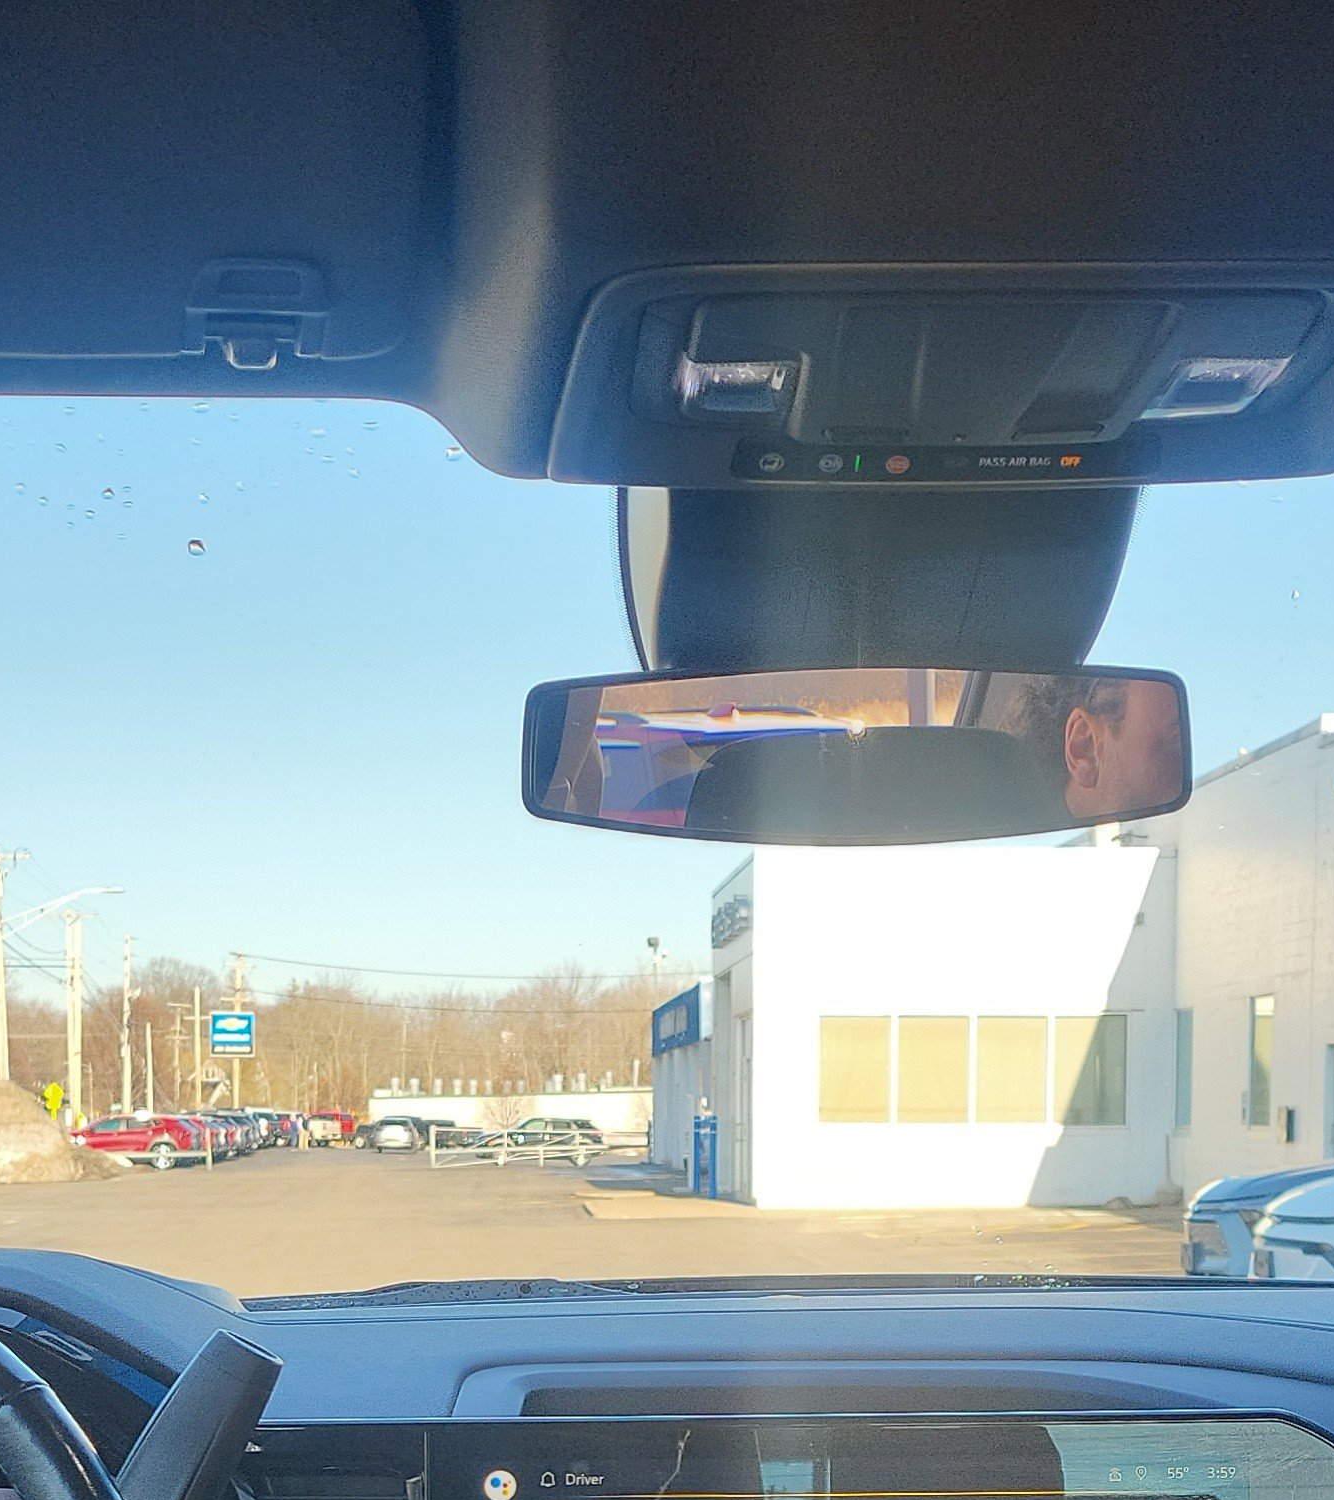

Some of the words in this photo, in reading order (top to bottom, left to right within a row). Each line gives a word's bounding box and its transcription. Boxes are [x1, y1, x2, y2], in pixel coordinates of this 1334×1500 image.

[979, 456, 1006, 468] PASS
[1008, 456, 1026, 468] AIR
[1029, 456, 1052, 467] BAG
[1060, 455, 1082, 468] OFF
[1207, 1466, 1236, 1479] 3:59
[565, 1473, 605, 1486] Driver
